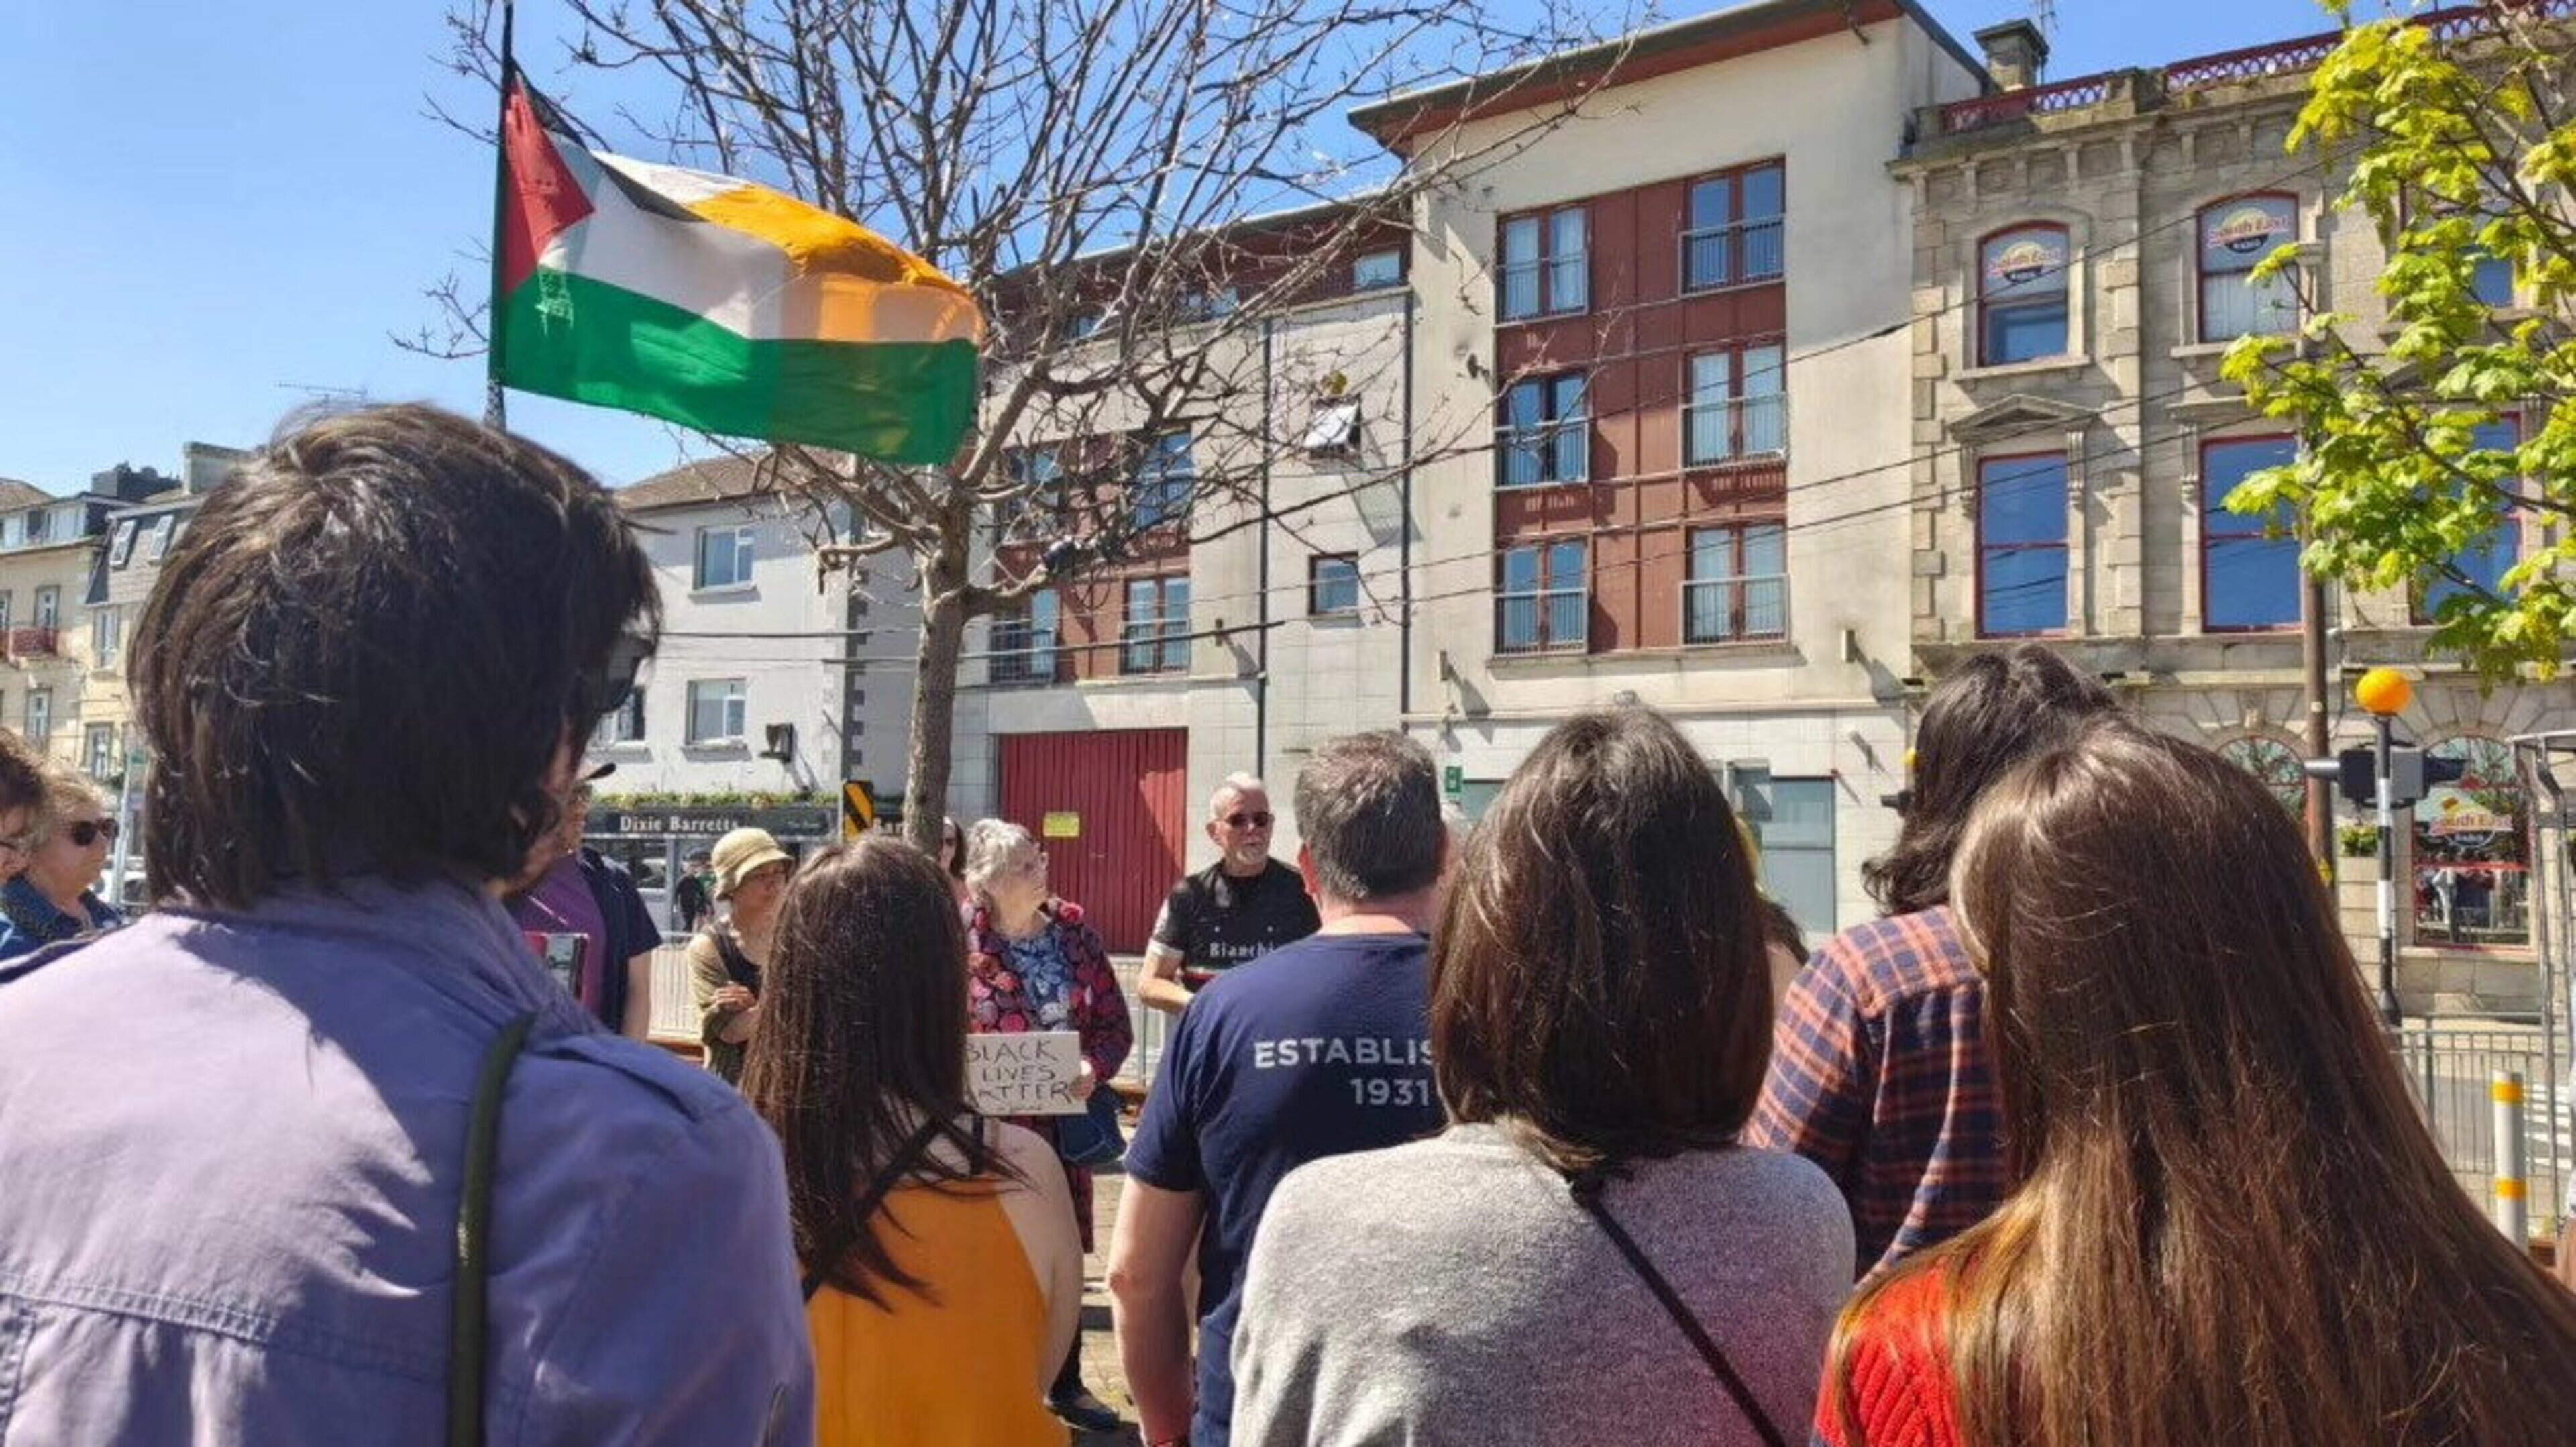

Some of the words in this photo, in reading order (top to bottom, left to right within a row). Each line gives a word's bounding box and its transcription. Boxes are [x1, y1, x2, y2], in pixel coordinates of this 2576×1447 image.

[620, 816, 662, 831] Dixie
[670, 816, 738, 831] Barretts
[1210, 941, 1275, 957] Bianchi
[965, 1039, 1058, 1063] BLACK
[982, 1065, 1057, 1082] LIVES
[977, 1081, 1072, 1104] ATTER
[1351, 1078, 1430, 1106] 1931
